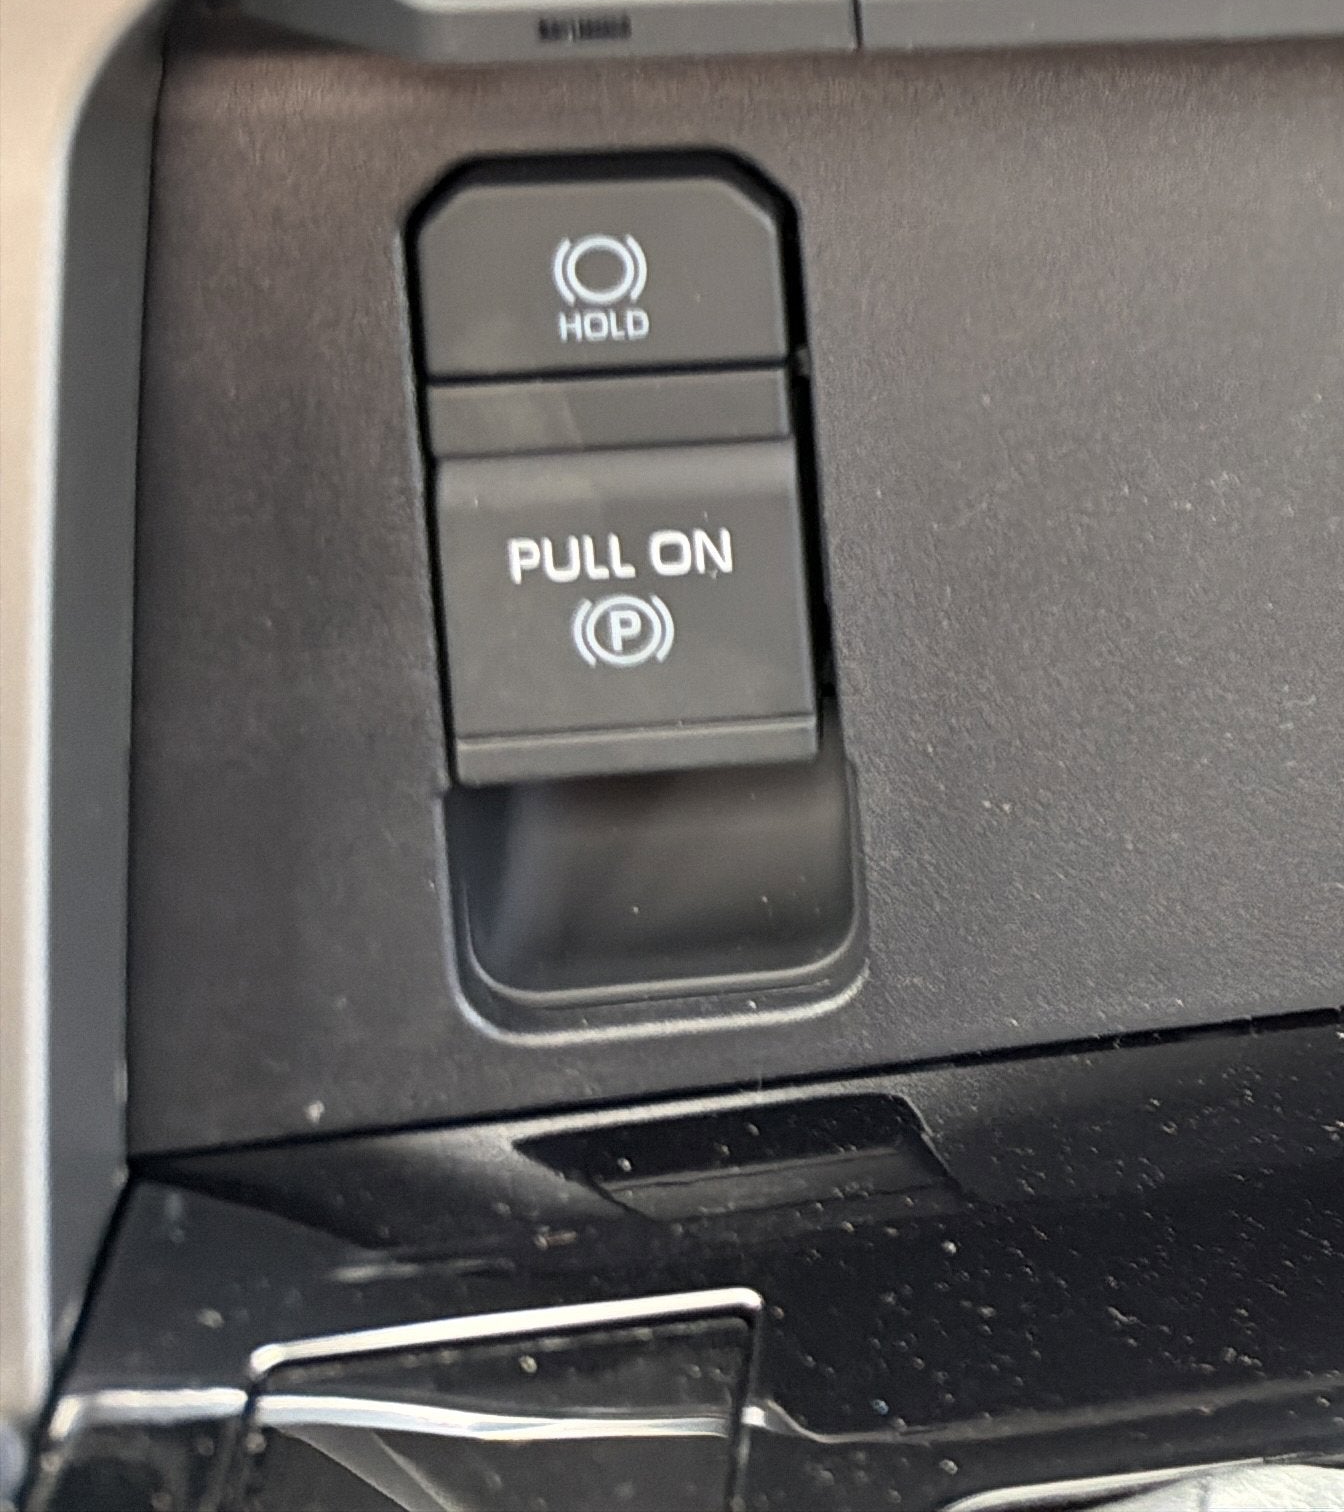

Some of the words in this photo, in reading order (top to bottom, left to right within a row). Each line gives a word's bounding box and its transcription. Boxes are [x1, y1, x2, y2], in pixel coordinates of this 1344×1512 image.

[560, 308, 650, 342] HOLD
[508, 533, 636, 585] PULL
[650, 527, 733, 576] ON
